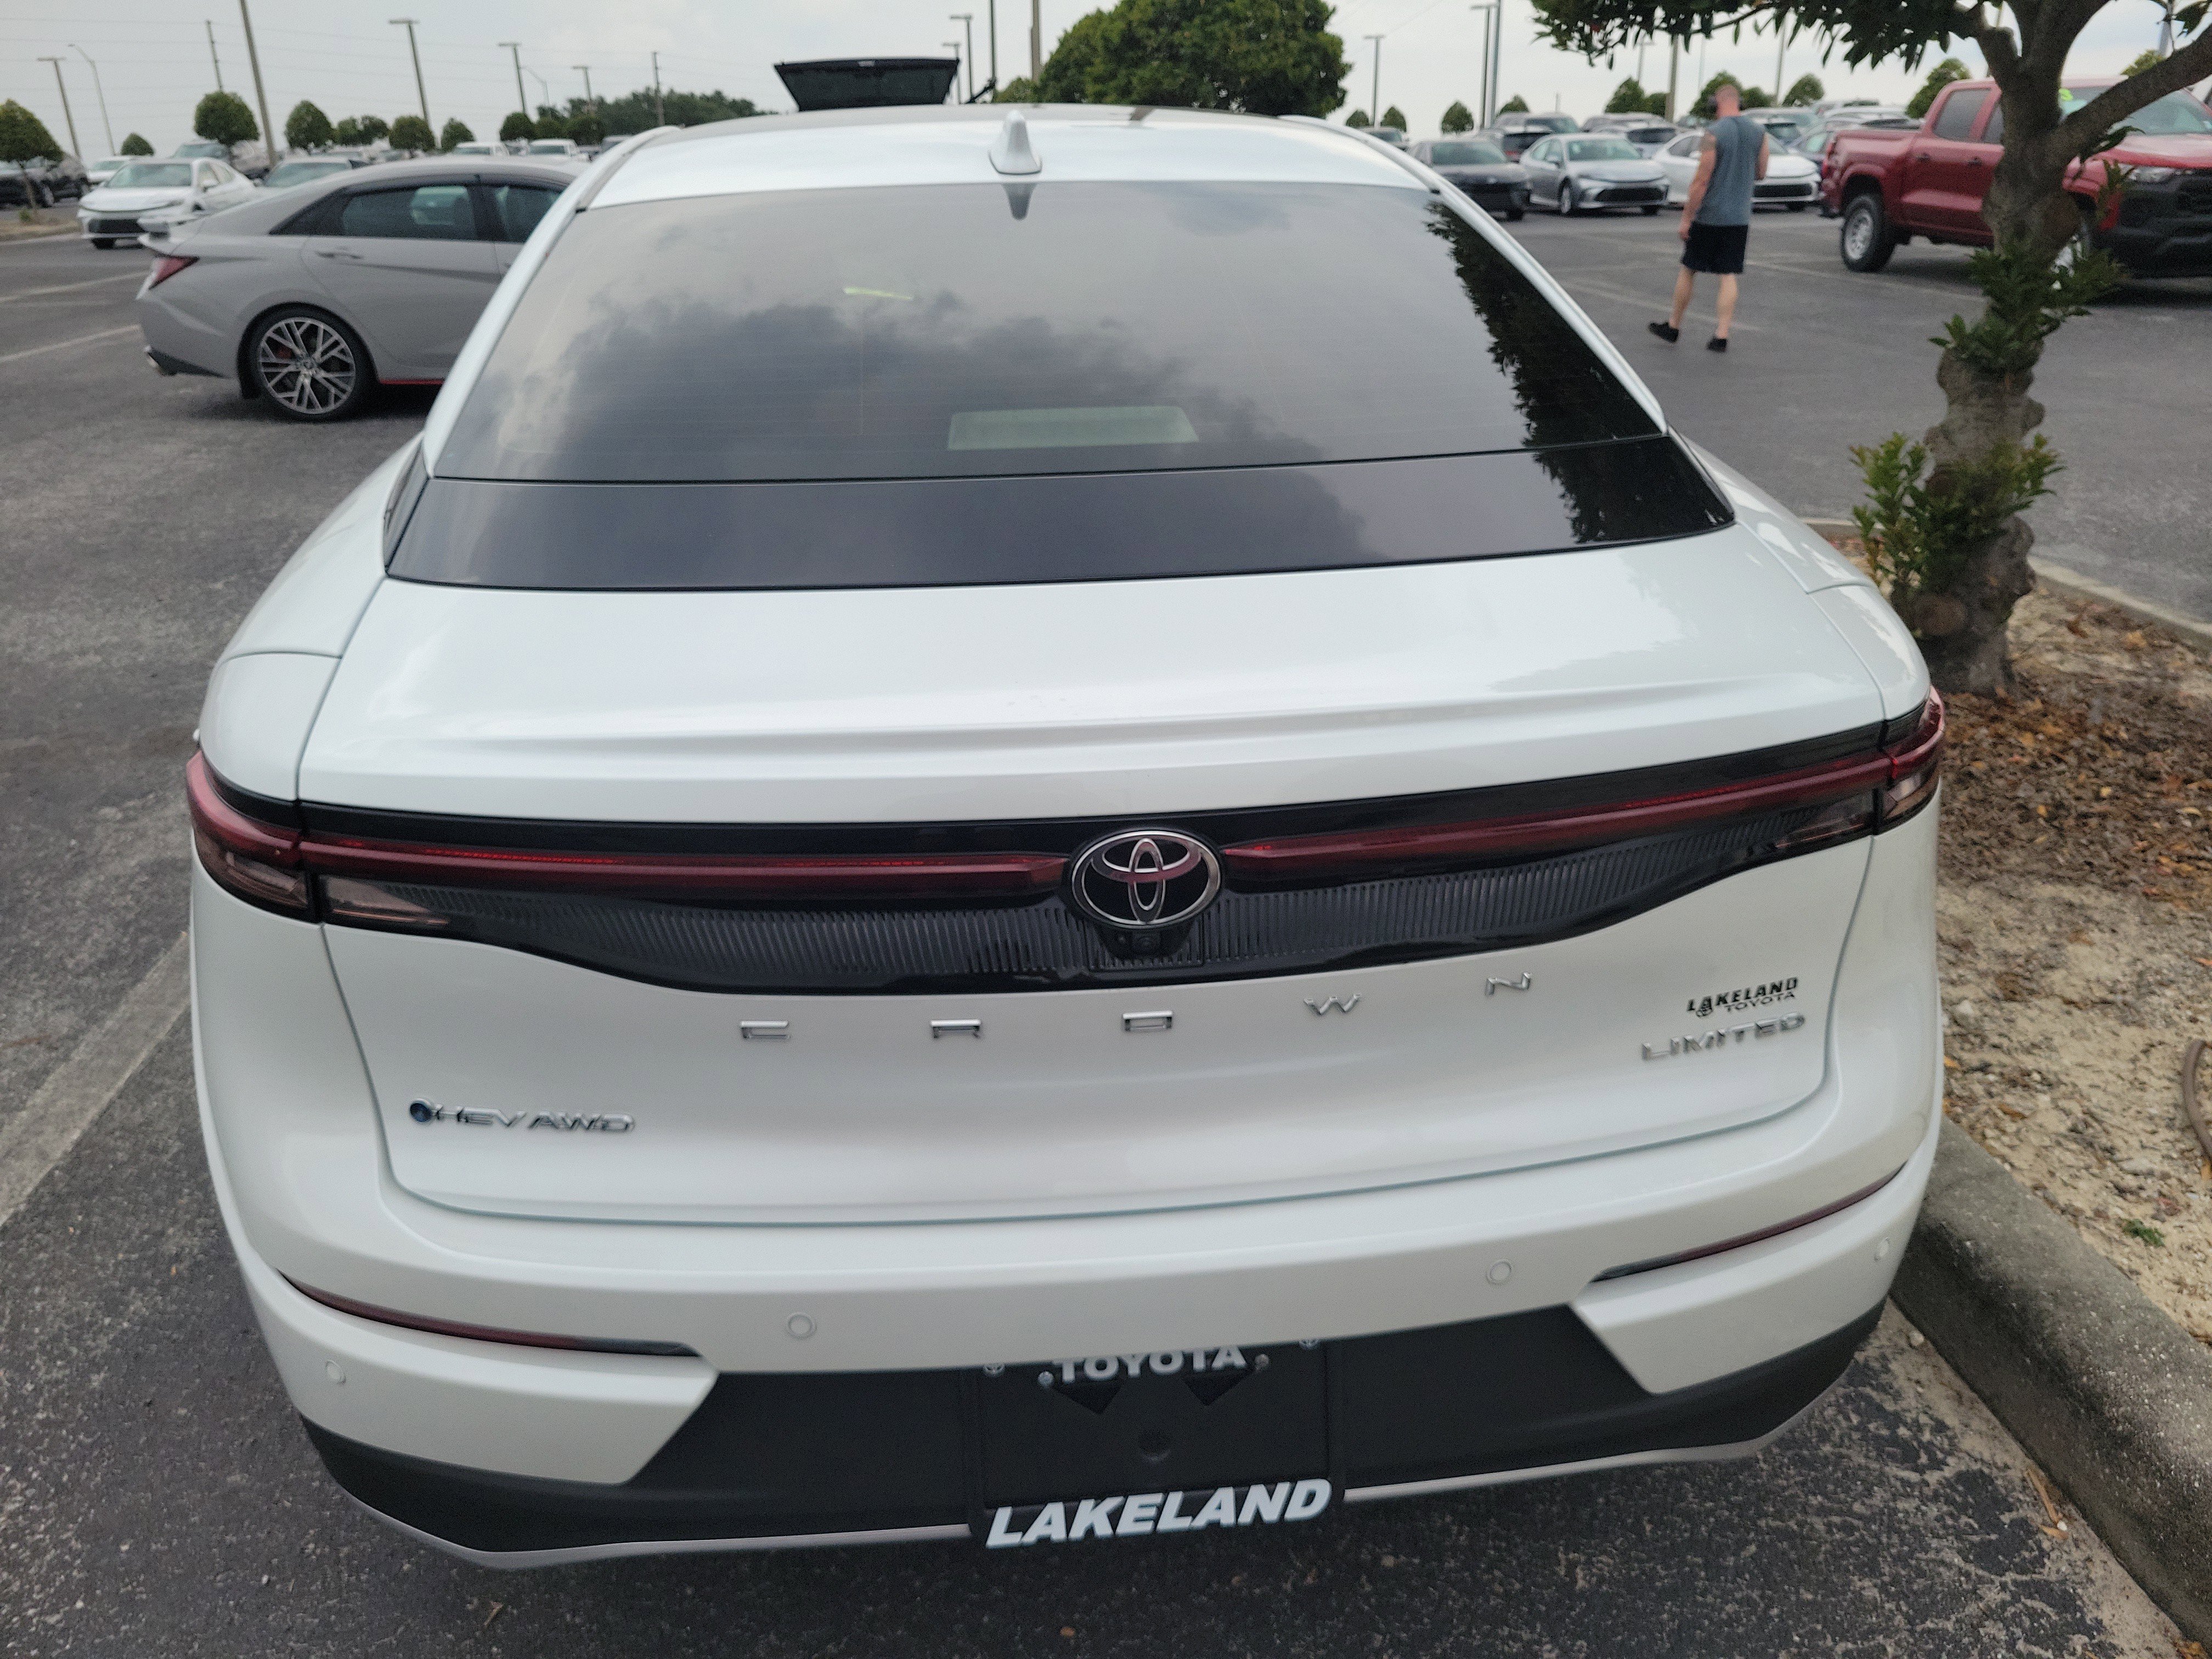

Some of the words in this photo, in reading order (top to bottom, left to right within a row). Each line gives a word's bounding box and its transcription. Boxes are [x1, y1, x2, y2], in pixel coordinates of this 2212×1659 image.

[1687, 977, 1798, 1011] LAKELAND
[1725, 991, 1795, 1012] TOYOTA
[1641, 1011, 1805, 1060] LIMITED
[528, 1110, 635, 1132] AWD
[1053, 1347, 1247, 1384] TOYOTA
[986, 1479, 1331, 1548] LAKELAND
